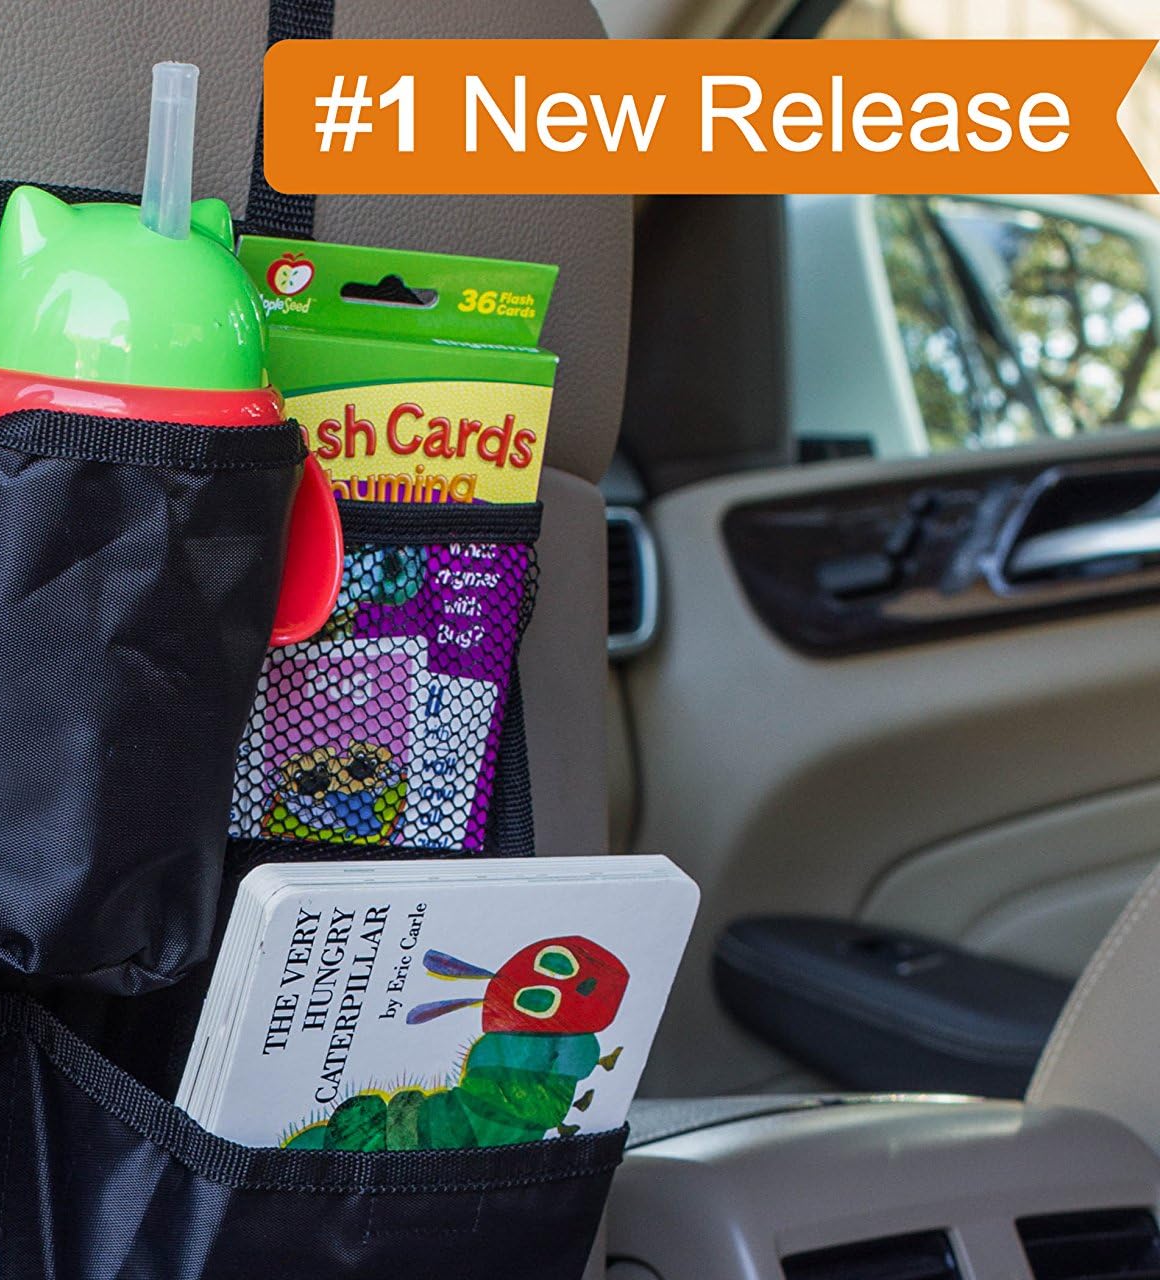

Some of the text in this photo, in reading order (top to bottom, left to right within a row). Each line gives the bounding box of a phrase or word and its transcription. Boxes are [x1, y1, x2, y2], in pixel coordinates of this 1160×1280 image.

[457, 288, 534, 314] 36 Flash
[497, 304, 536, 318] Cards
[299, 402, 536, 468] sh Cards
[263, 907, 322, 1055] THE VERY
[302, 907, 355, 1032] HUNGRY
[315, 904, 391, 1104] CATERPILLAR
[379, 903, 427, 1019] by Eric Carle
